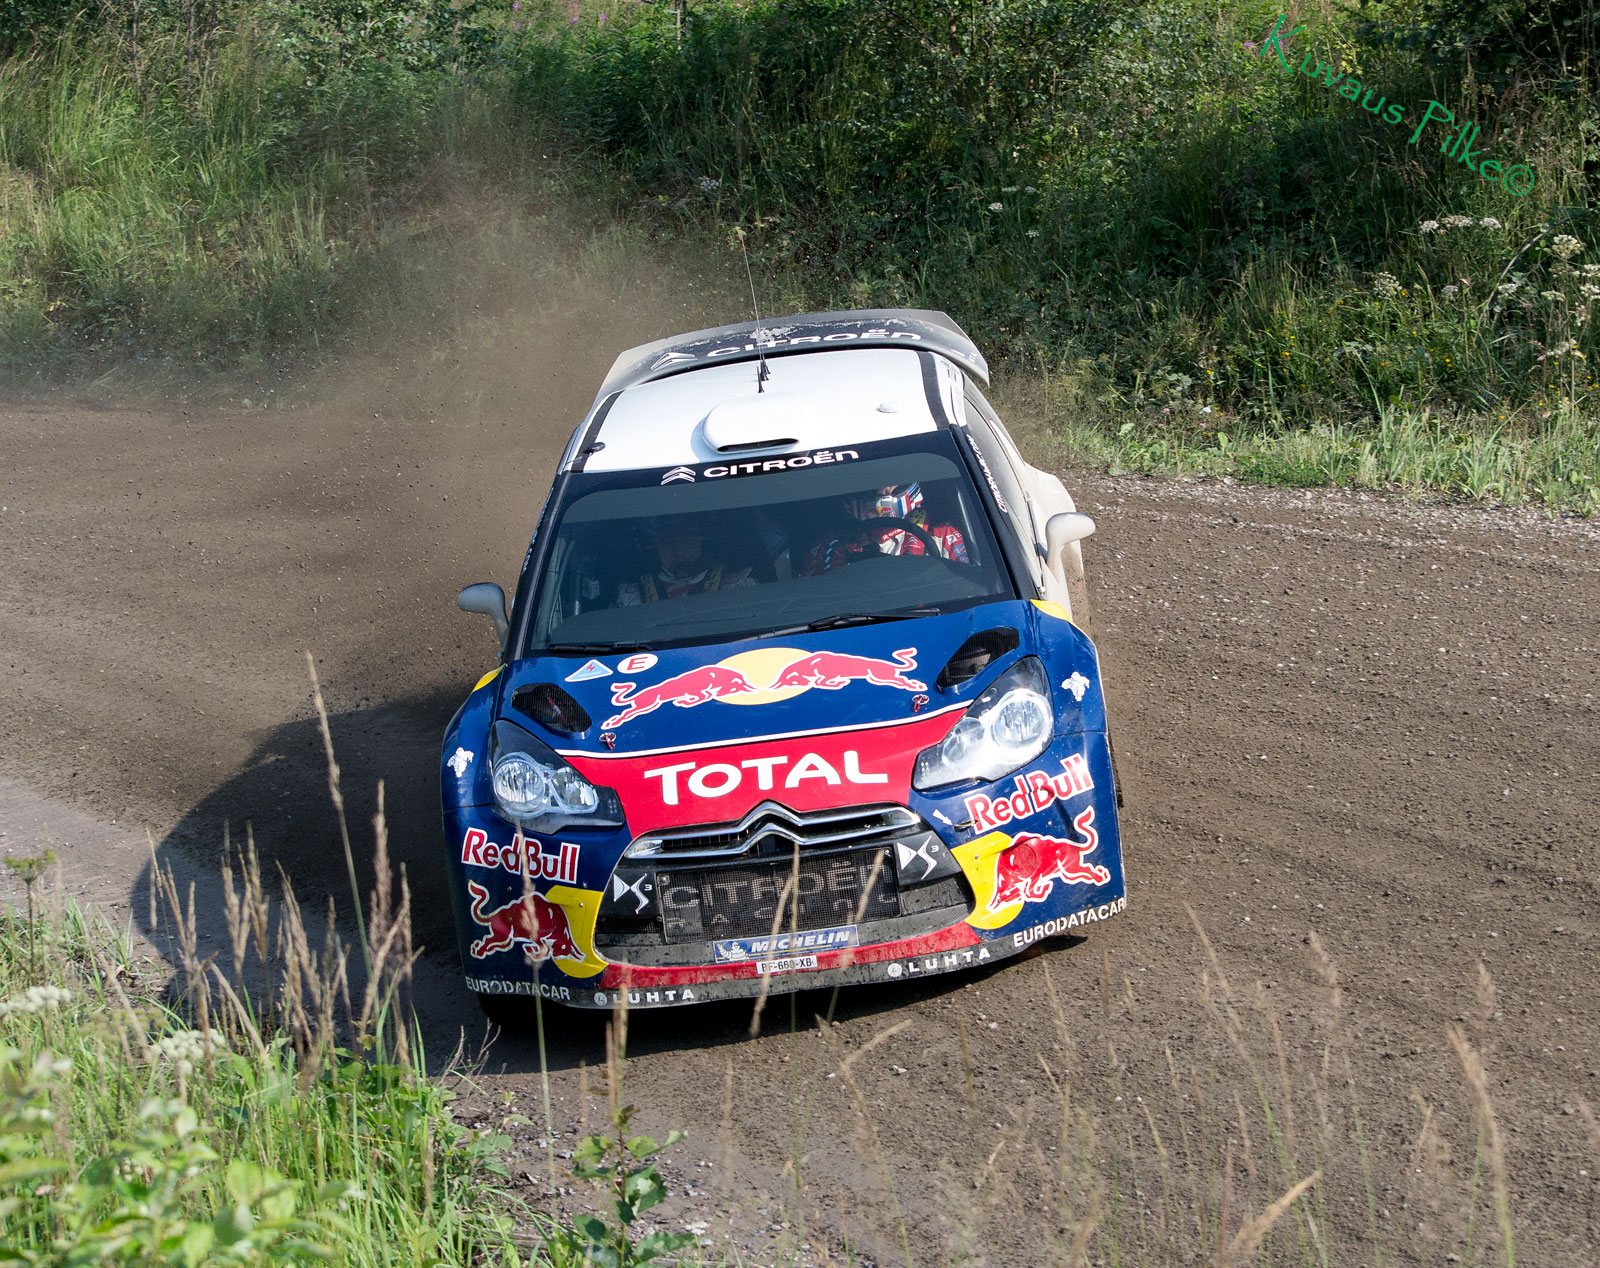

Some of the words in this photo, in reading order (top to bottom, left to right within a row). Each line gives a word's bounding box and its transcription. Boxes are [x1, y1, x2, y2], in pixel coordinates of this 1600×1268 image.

[627, 656, 648, 671] E
[643, 750, 888, 805] TOTAL
[1013, 898, 1127, 947] EURODATACAR
[751, 930, 850, 953] MICHELIN
[908, 948, 991, 973] LUHTA
[465, 976, 571, 1000] EURODATACAR
[613, 988, 695, 1004] LUHTA
